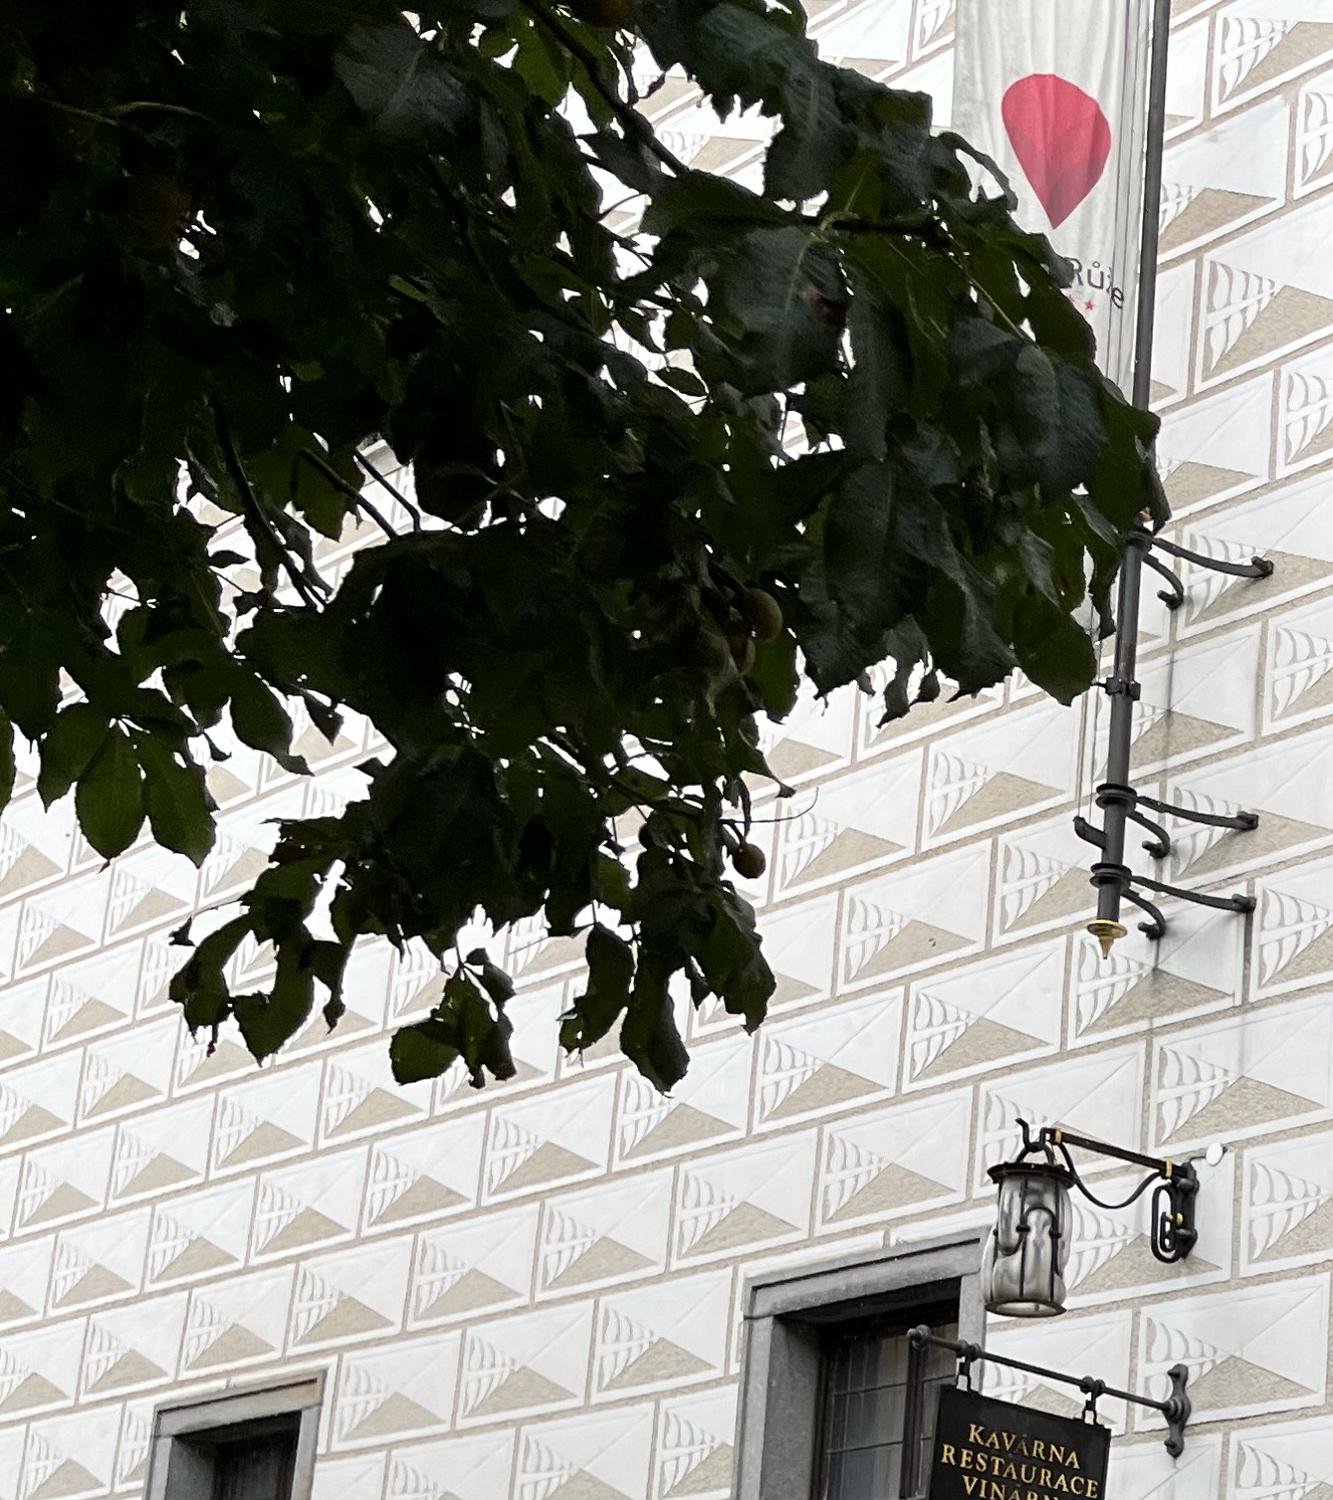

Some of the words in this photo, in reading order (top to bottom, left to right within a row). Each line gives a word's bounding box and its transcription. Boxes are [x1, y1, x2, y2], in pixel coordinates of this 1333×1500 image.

[1063, 256, 1125, 309] Růe
[941, 1443, 1099, 1499] RESTAURACE
[968, 1423, 1081, 1470] KAVÁRNA
